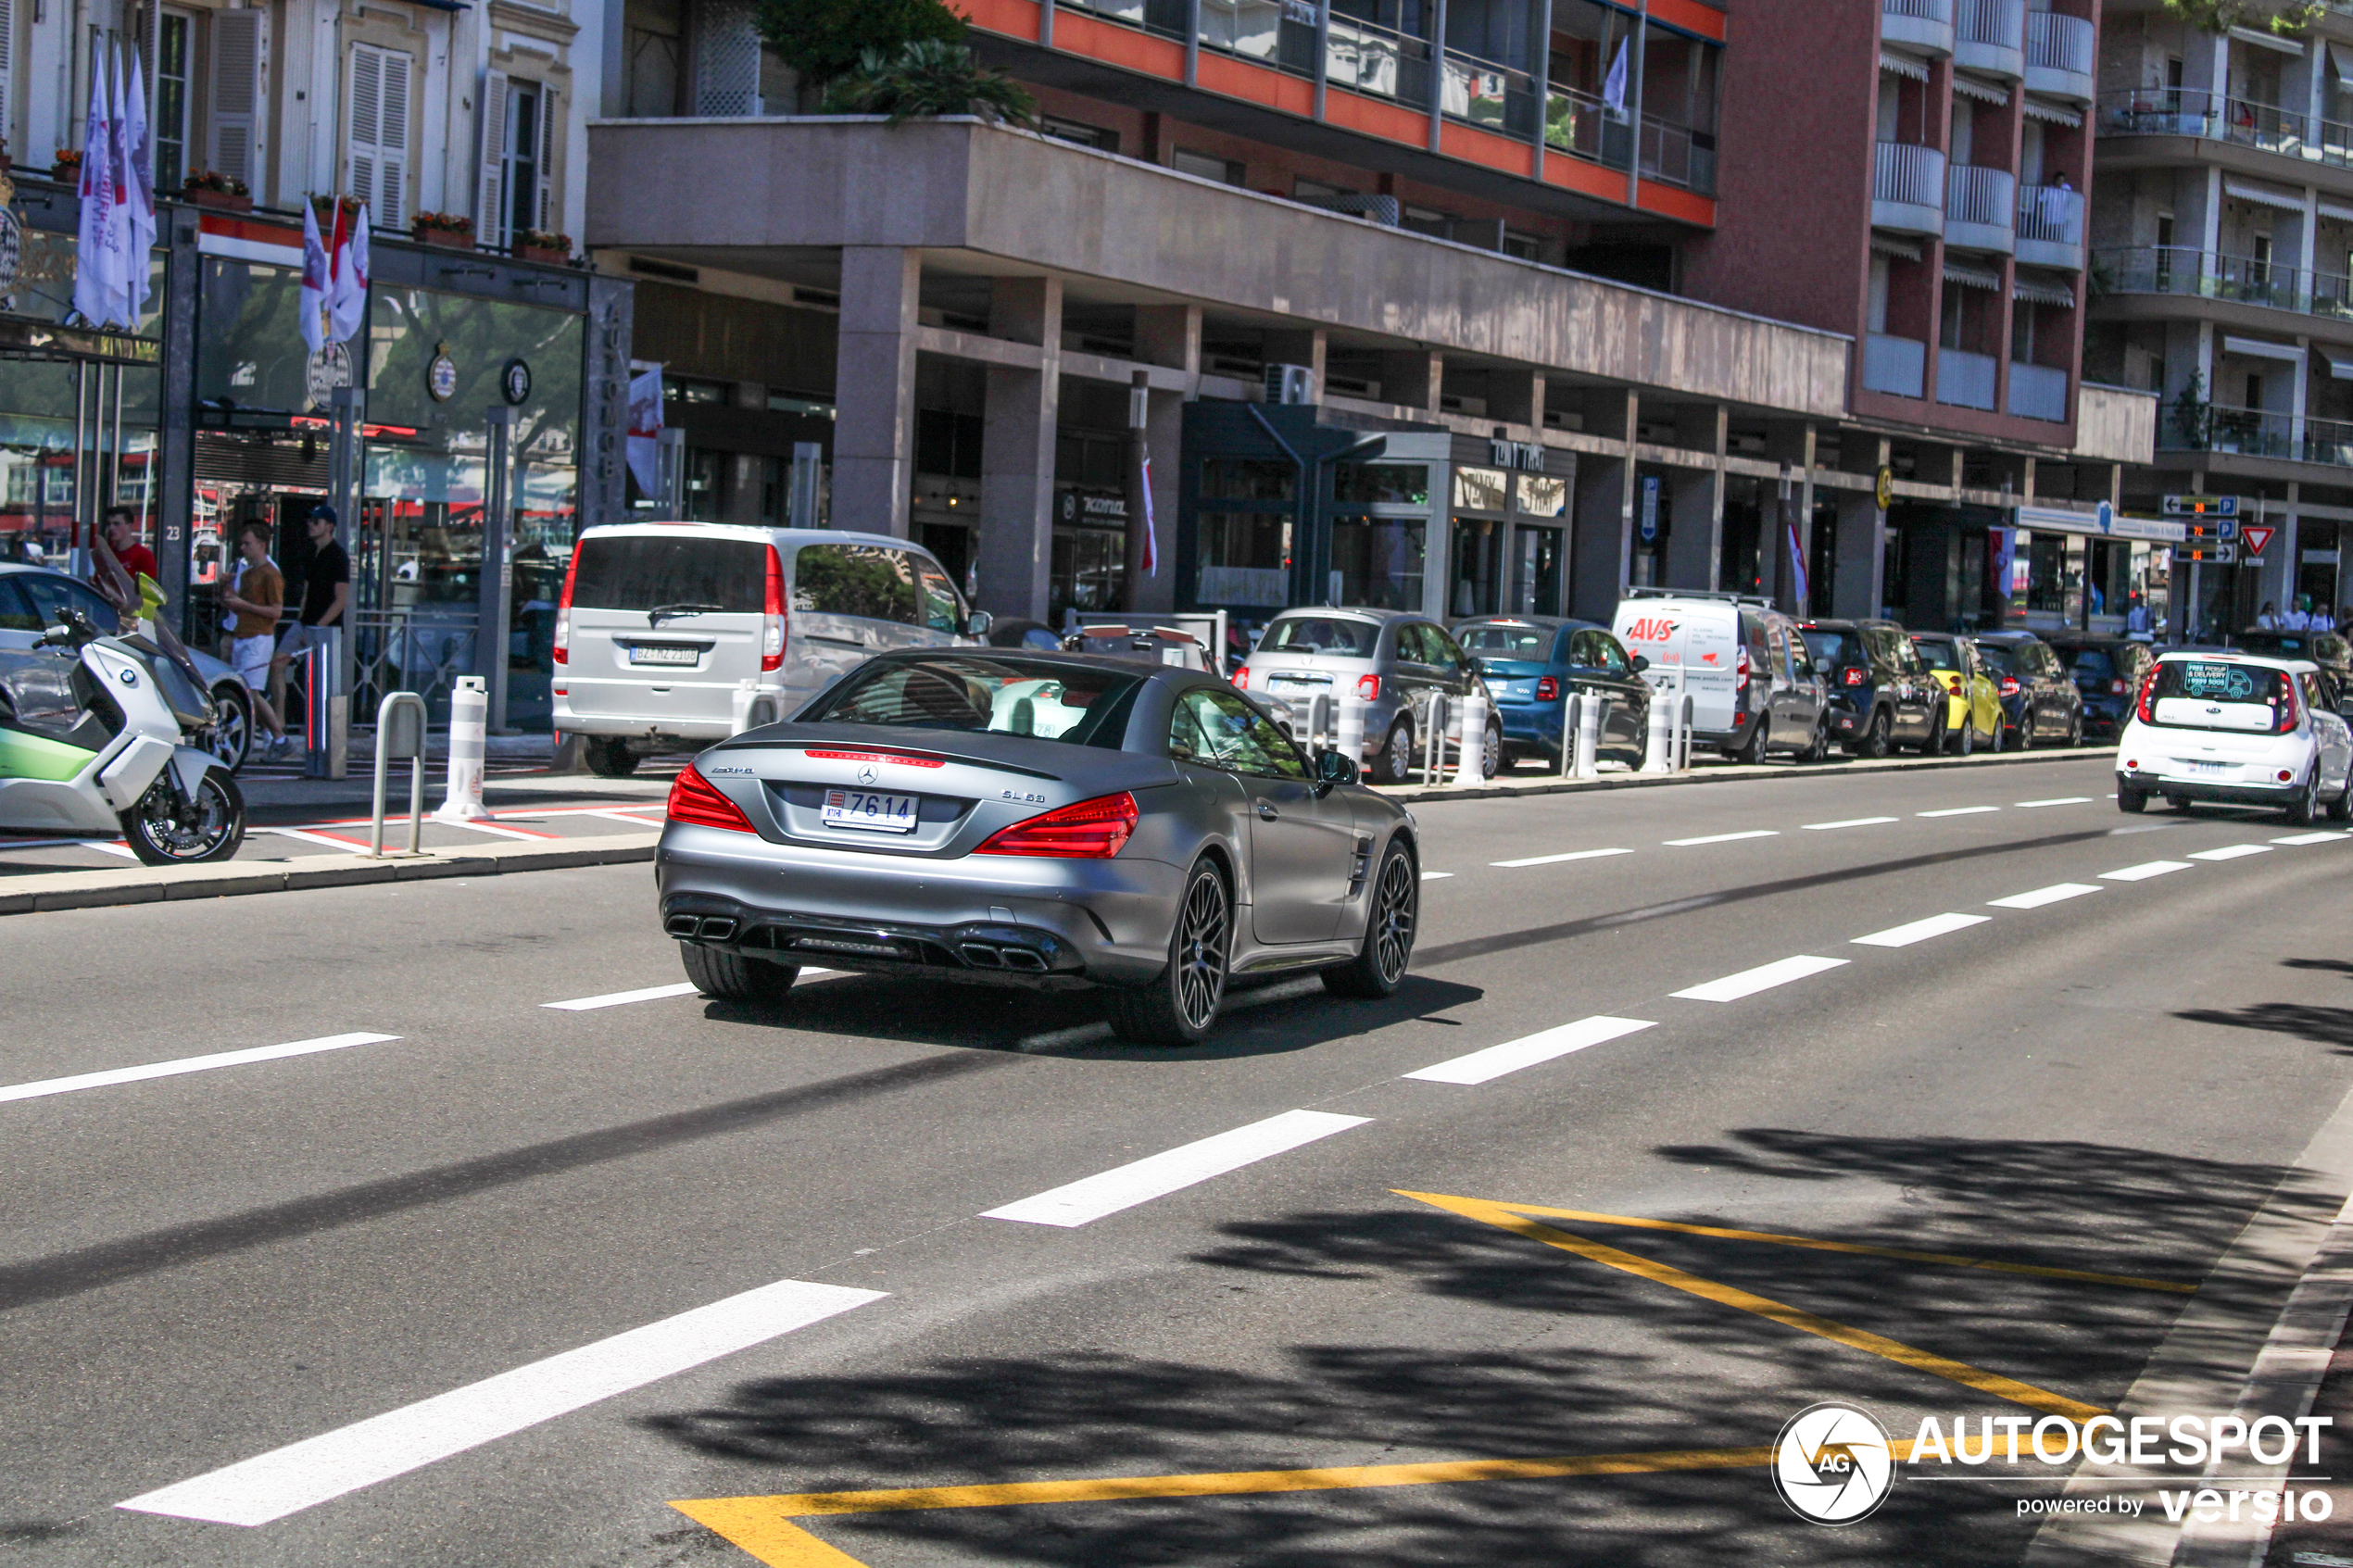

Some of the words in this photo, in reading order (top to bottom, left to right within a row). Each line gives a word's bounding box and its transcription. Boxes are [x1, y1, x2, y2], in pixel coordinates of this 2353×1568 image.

[2223, 501, 2231, 512] P
[167, 526, 180, 541] 23
[2194, 526, 2204, 536] 72
[2221, 523, 2230, 534] P
[1629, 618, 1675, 642] AVS
[637, 647, 649, 659] BZ
[1001, 789, 1022, 800] SL
[1024, 792, 1045, 803] 63
[828, 809, 841, 817] MC
[850, 794, 909, 820] 7614
